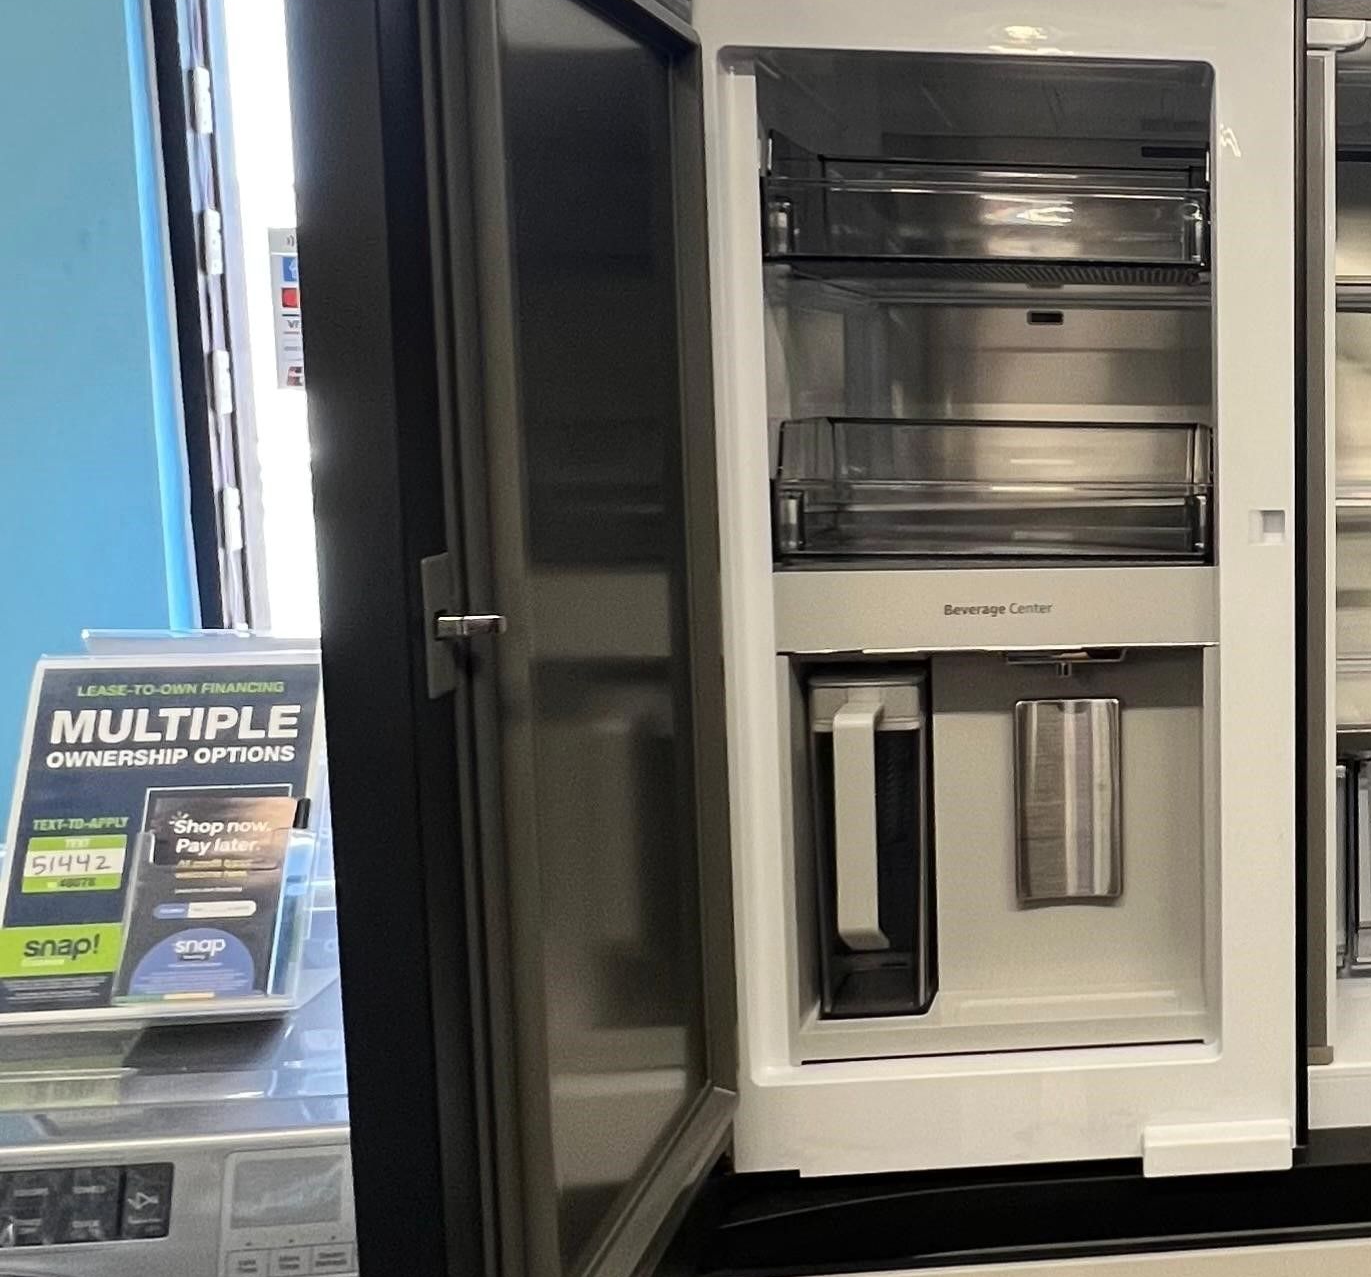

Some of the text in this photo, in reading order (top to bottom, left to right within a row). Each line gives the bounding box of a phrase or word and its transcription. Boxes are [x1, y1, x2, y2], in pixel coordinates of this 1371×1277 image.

[944, 603, 1053, 617] Beverage Center
[78, 681, 285, 698] LEASE-TO-OWN FINANCING
[50, 704, 301, 744] MULTIPLE
[46, 745, 296, 769] OWNERSHIP OPTIONS
[33, 816, 129, 832] TEXT-TO-APPLY
[173, 819, 272, 837] Shop now.
[175, 838, 261, 856] Pay later.
[32, 854, 112, 876] 51442
[23, 933, 101, 961] snap!
[174, 938, 227, 957] snap
